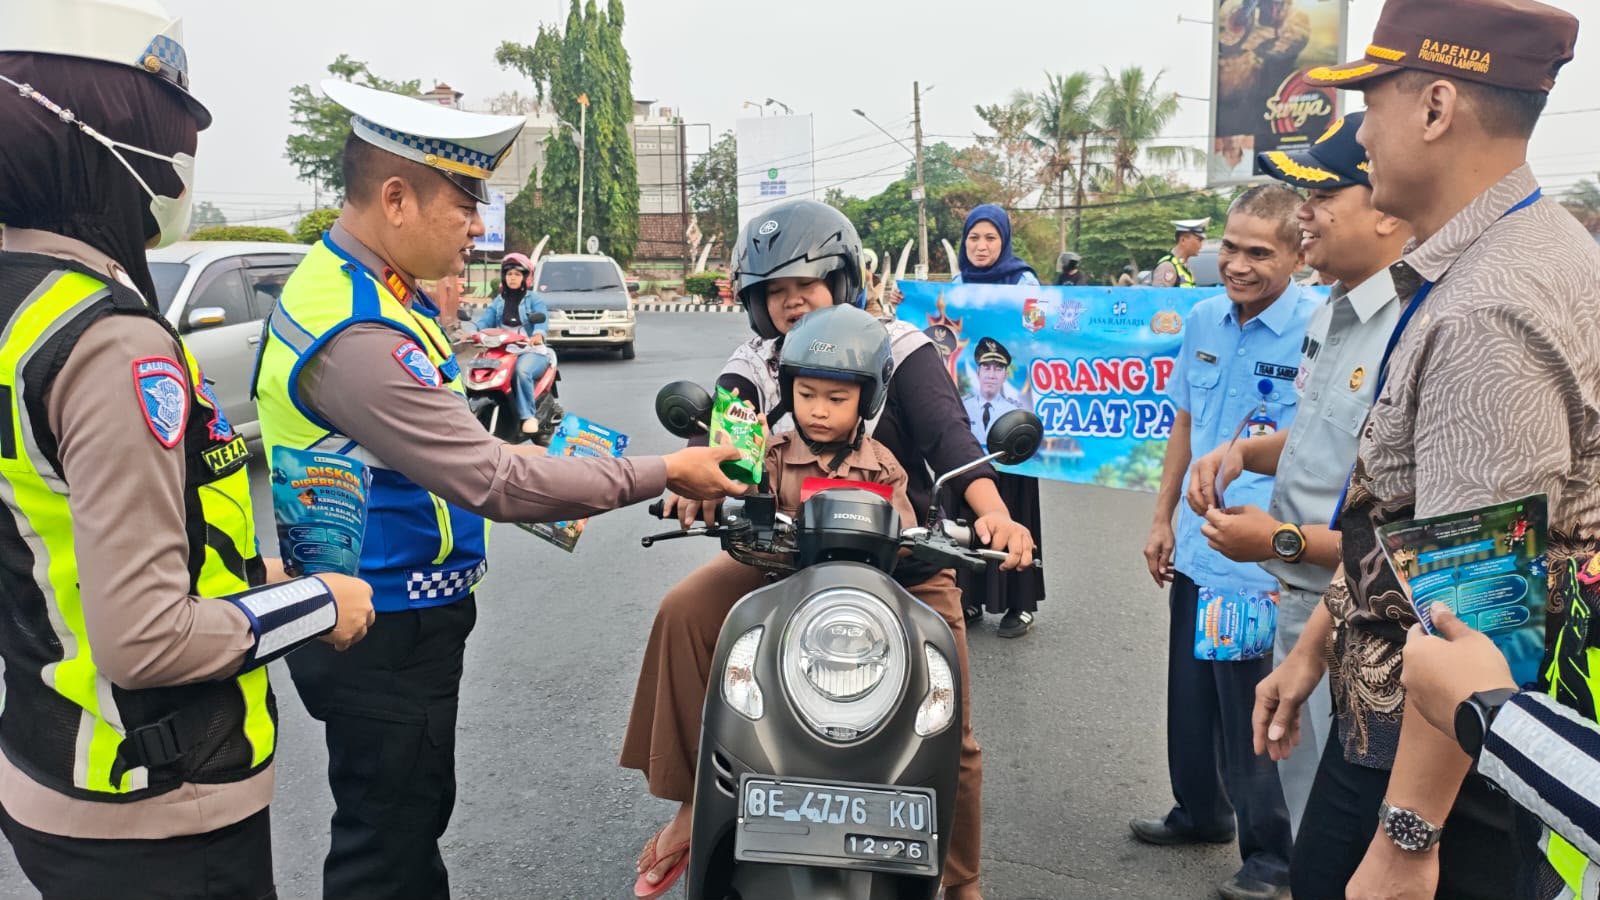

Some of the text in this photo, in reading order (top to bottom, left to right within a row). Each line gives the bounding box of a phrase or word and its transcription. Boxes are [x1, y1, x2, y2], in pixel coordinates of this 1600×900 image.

[1418, 48, 1489, 73] PROVINSI LAMPUNG
[1421, 38, 1490, 63] BAPENDA
[1088, 316, 1106, 325] JASA
[1032, 361, 1146, 392] ORANG
[729, 405, 756, 422] MILO
[1041, 402, 1129, 434] TAAT
[206, 438, 248, 468] NEZA
[306, 466, 360, 488] DISKON
[833, 513, 872, 524] HONDA
[749, 788, 925, 831] BE 4776 KU
